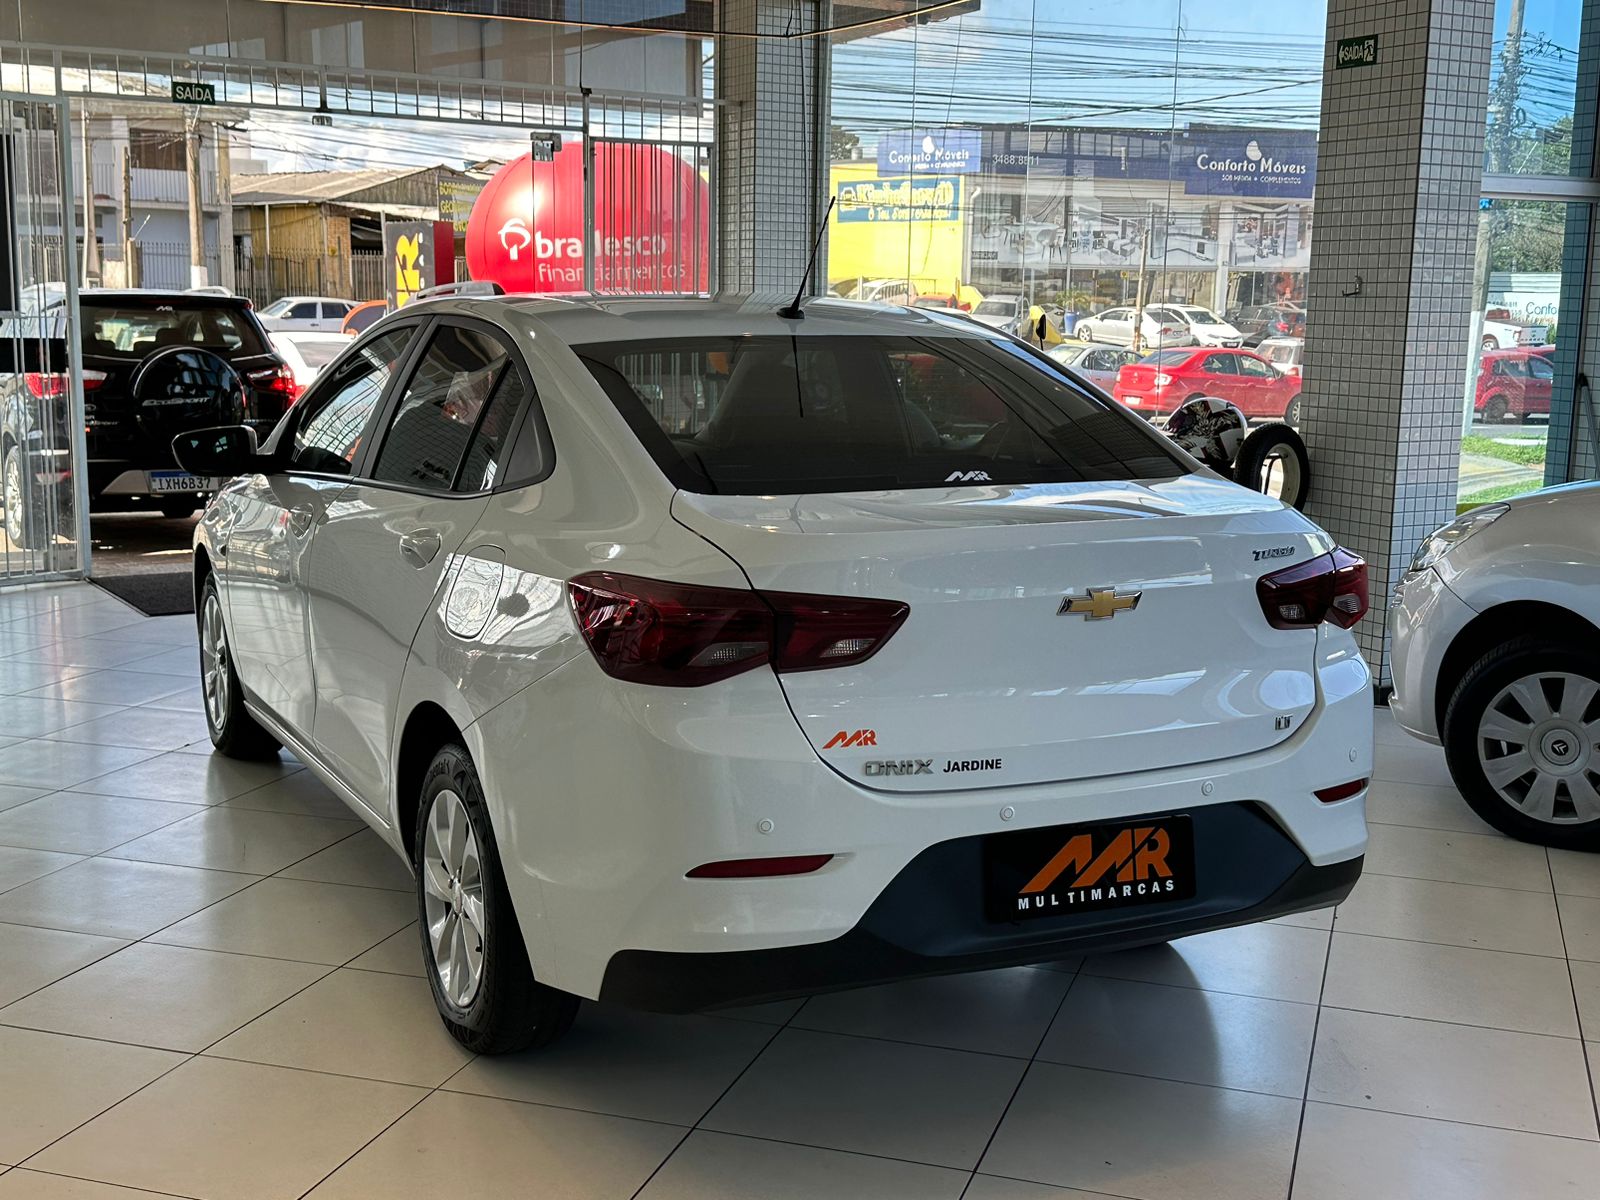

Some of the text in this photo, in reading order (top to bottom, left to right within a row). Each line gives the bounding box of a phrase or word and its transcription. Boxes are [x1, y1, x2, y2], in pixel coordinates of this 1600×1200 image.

[1343, 42, 1364, 61] SAÍDA
[176, 84, 213, 101] SAÍDA
[1197, 154, 1306, 174] Conforto Móveis
[158, 477, 211, 490] IXH6B37
[865, 758, 1002, 777] ONIX JARDINE
[1018, 879, 1175, 910] MULTIMARCAS
